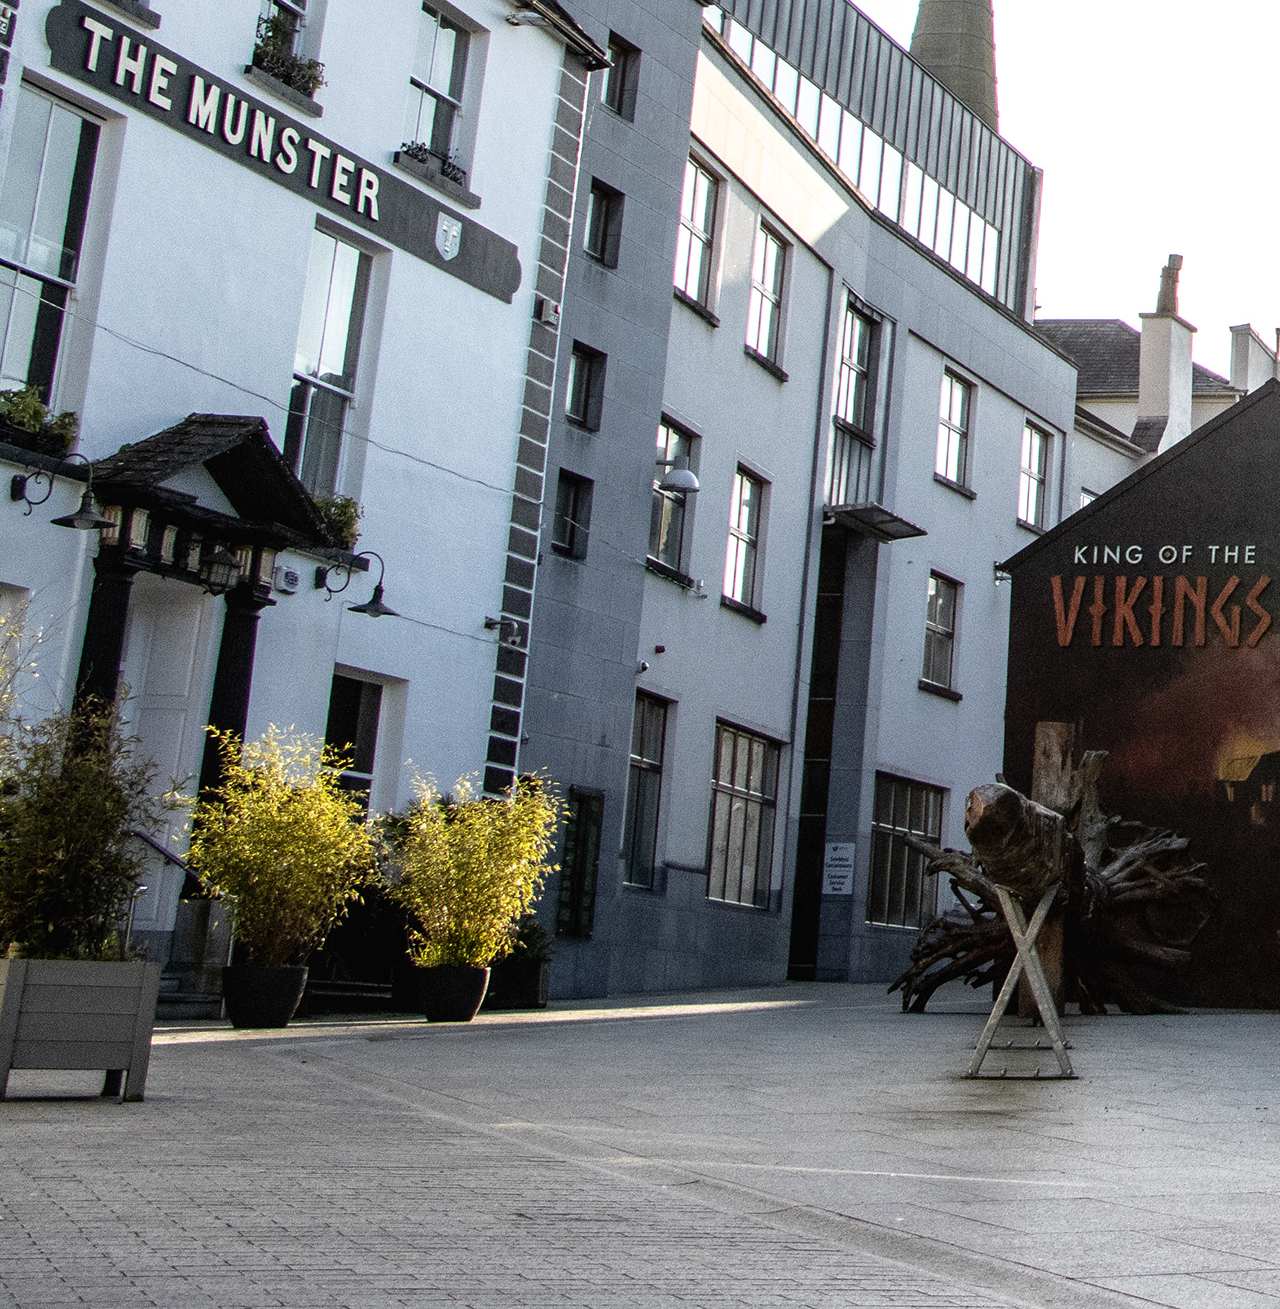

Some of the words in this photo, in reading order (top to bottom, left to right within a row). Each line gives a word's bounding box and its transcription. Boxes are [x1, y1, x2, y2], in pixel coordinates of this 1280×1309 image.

[82, 15, 179, 112] THE
[187, 74, 380, 222] MUNSTER
[1073, 545, 1144, 565] KING
[1158, 545, 1193, 565] OF
[1208, 545, 1257, 565] THE
[1050, 574, 1273, 648] VIKINGS
